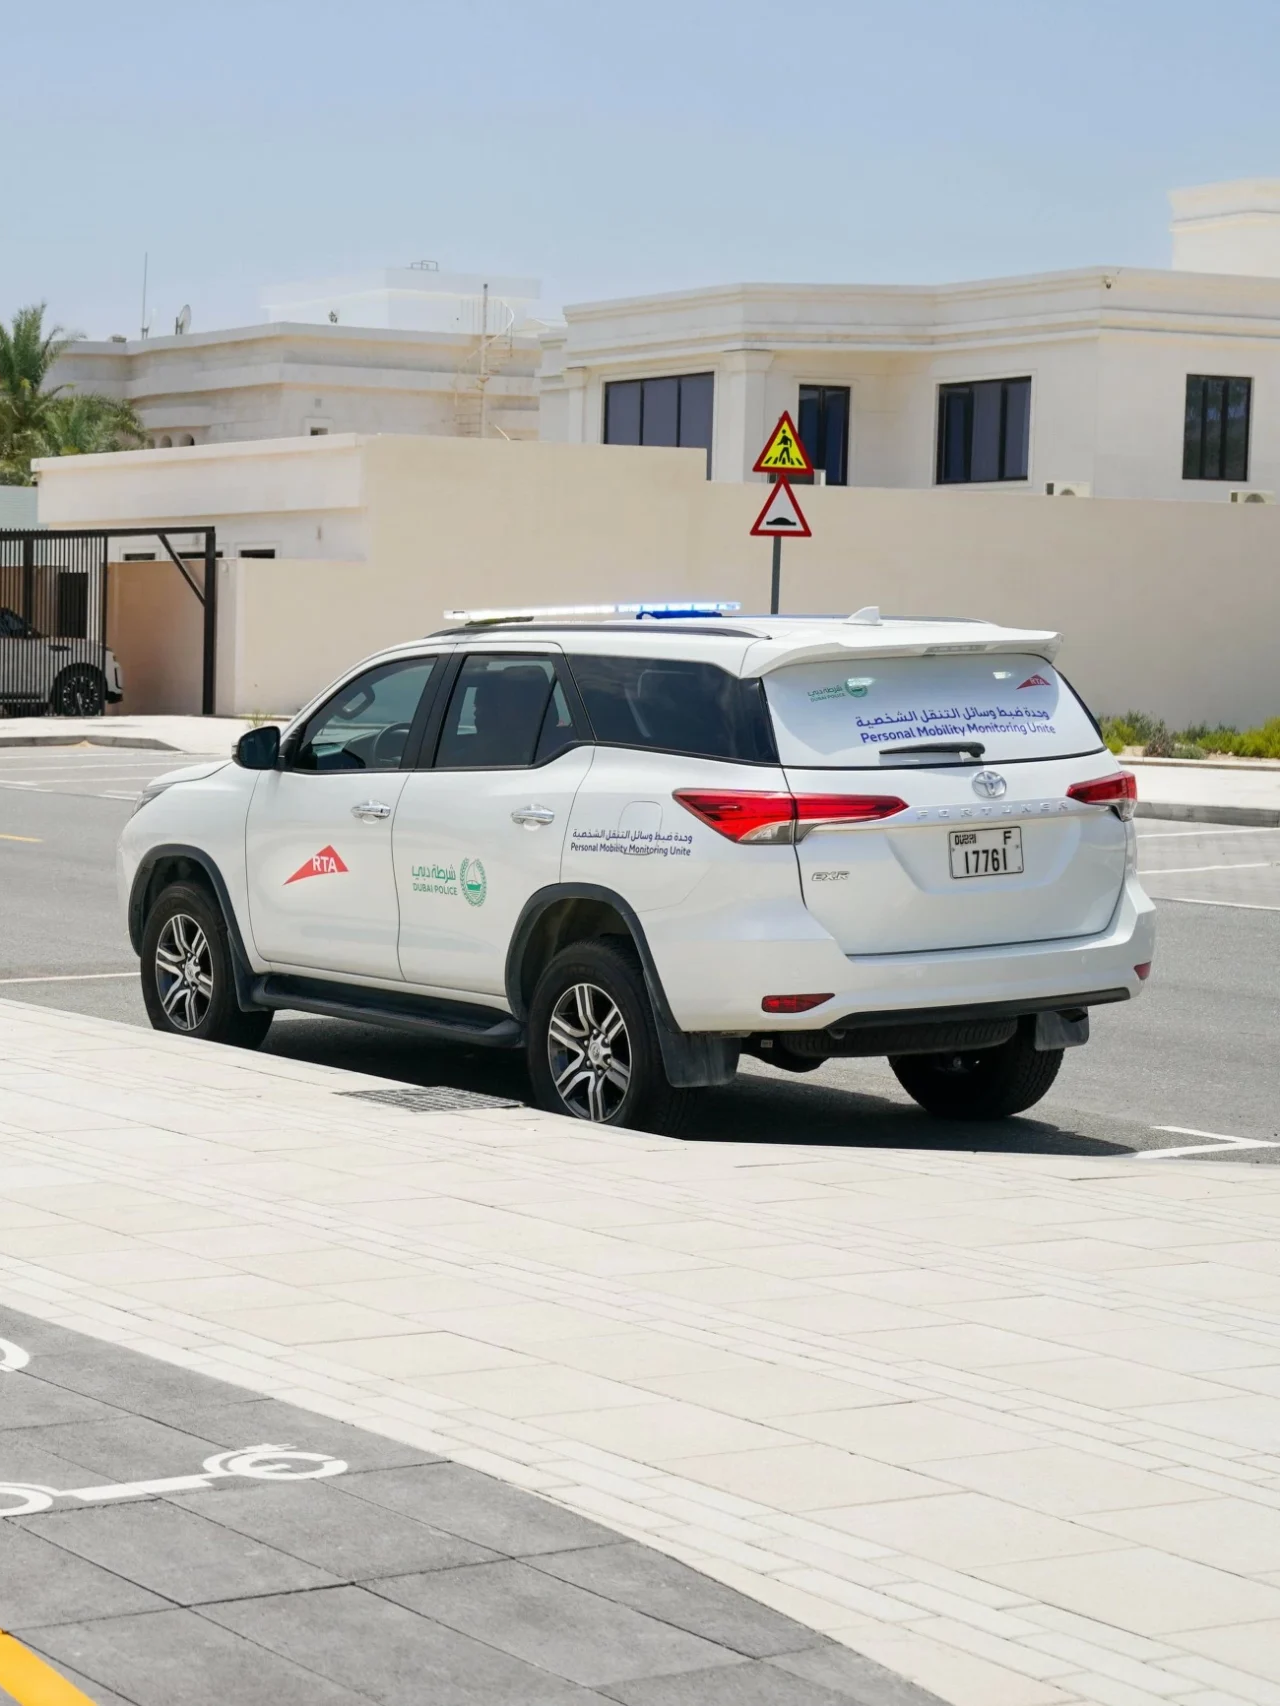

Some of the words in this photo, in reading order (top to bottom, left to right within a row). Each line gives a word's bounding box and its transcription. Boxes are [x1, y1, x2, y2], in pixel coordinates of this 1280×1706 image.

[1029, 677, 1046, 686] RTA
[855, 710, 918, 729] الشخصية
[920, 707, 960, 723] التنقل
[963, 706, 997, 721] وسائل
[996, 706, 1024, 720] ضبط
[1023, 707, 1050, 721] وحدة
[860, 726, 916, 743] Personal
[916, 722, 965, 737] Mobility
[966, 721, 1027, 735] Monitoring
[1027, 722, 1056, 734] Unite
[572, 828, 605, 840] الشخصية
[605, 829, 630, 841] التنقل
[630, 830, 653, 842] وسائل
[654, 831, 673, 844] ضبط
[673, 832, 693, 845] وحدة
[1003, 830, 1012, 845] F
[570, 842, 598, 851] Personal
[600, 843, 627, 855] Mobility
[629, 844, 669, 857] Monitoring
[670, 846, 691, 856] Unite
[312, 855, 338, 873] RTA
[965, 847, 1008, 875] 17761
[412, 865, 431, 882] دبي
[431, 863, 457, 883] شرطة
[412, 882, 433, 893] DUBAI
[434, 884, 458, 896] POLICE
